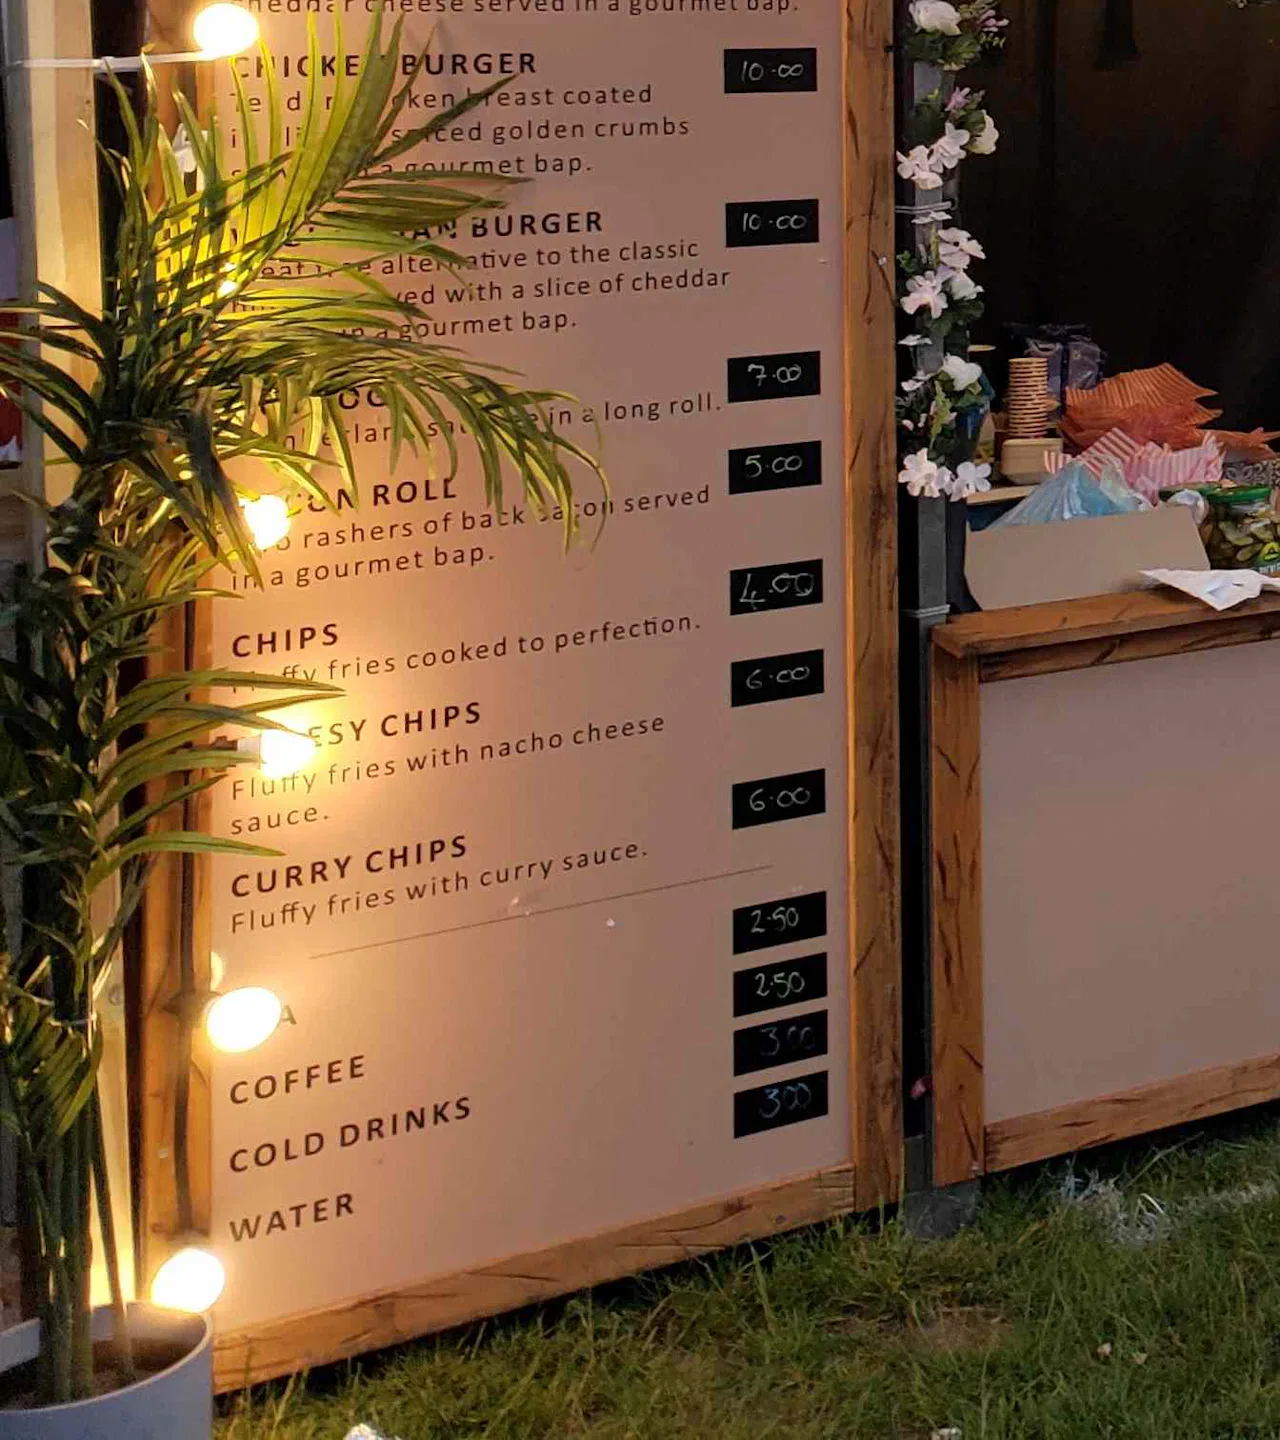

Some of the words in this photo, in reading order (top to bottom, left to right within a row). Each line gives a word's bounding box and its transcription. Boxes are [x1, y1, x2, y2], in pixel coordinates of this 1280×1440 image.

[232, 623, 339, 658] CHIPS
[380, 701, 481, 737] CHIPS
[230, 856, 353, 898] CURRY
[365, 835, 468, 874] CHIPS
[229, 1054, 367, 1105] COFFEE
[229, 1131, 326, 1173] COLD
[340, 1095, 472, 1147] DRINKS
[229, 1192, 356, 1242] WATER
